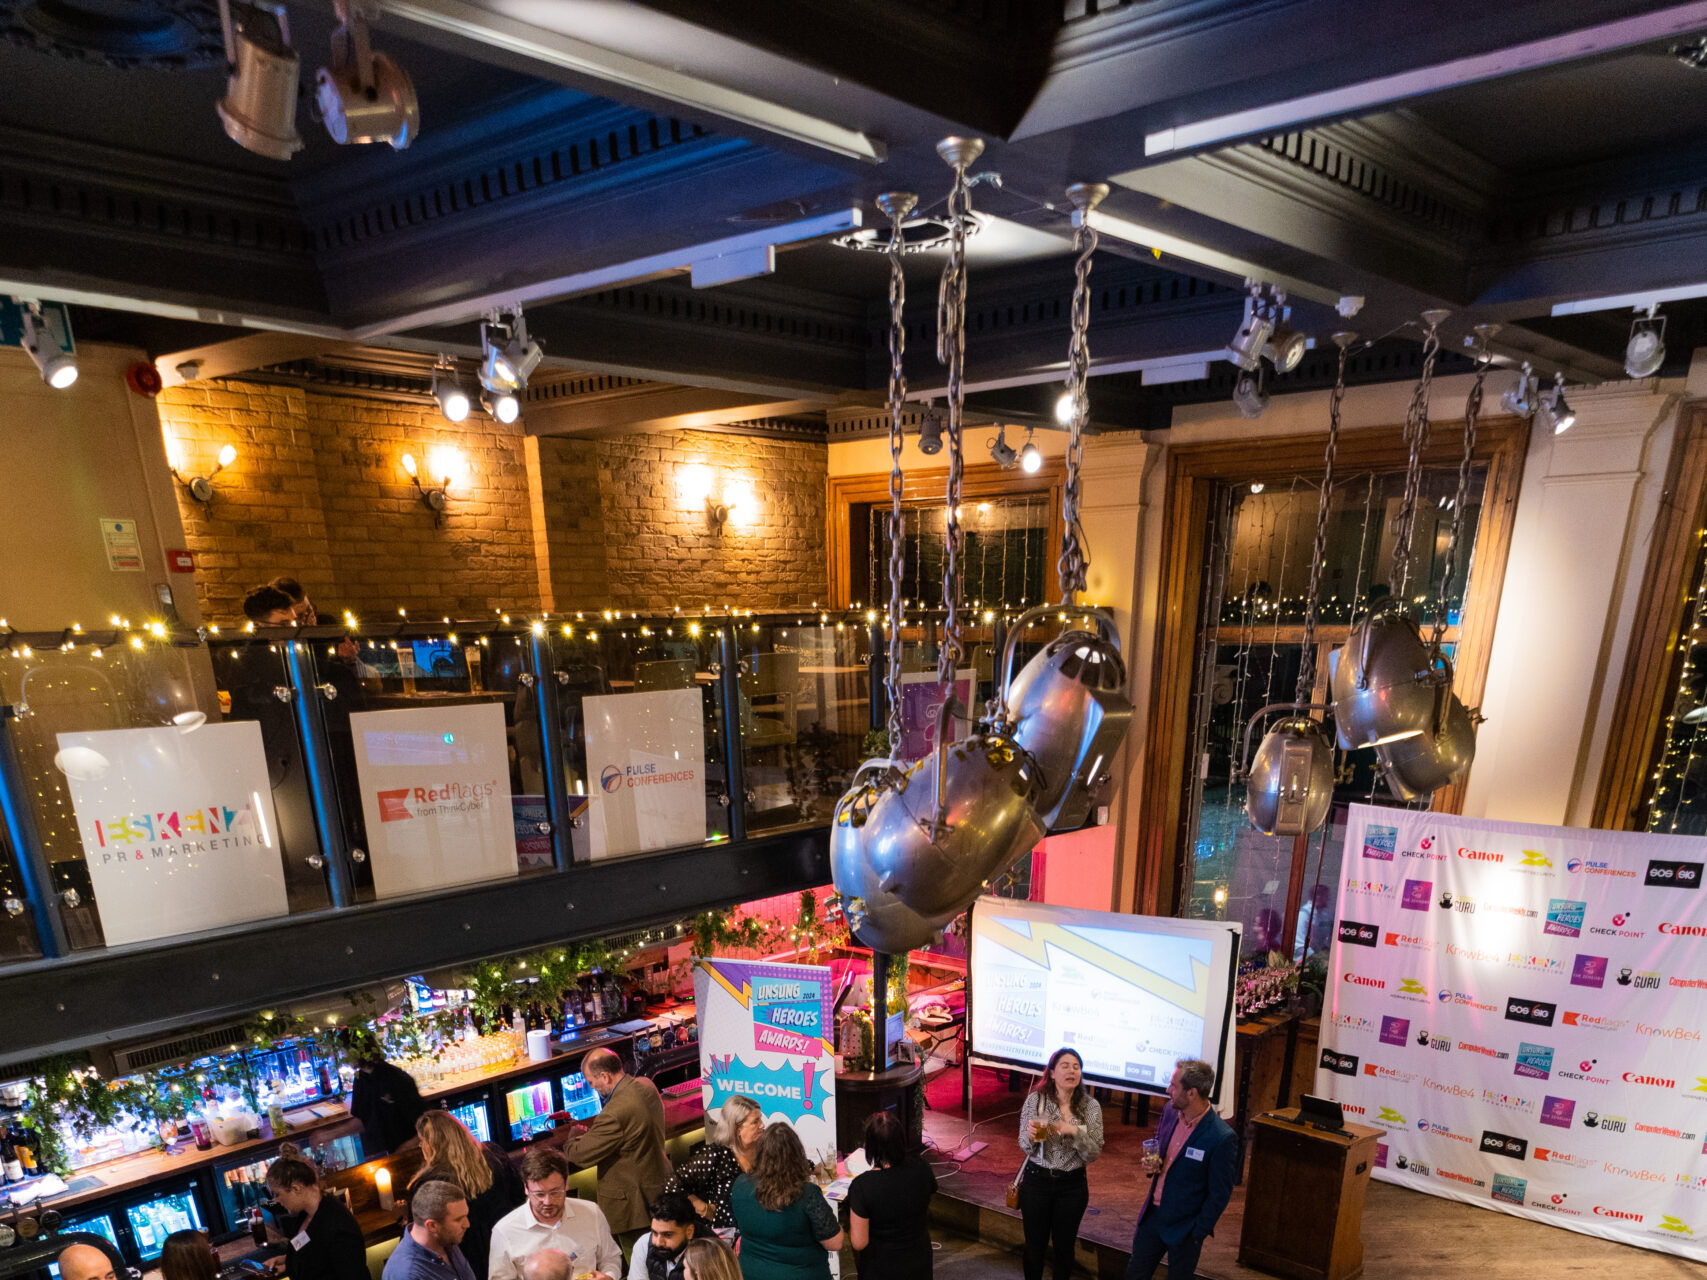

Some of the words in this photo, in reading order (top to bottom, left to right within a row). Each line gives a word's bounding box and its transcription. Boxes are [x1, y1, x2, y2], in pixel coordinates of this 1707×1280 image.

[626, 764, 656, 776] PULSE
[627, 770, 694, 788] CONFERENCES
[417, 808, 436, 816] from
[439, 802, 483, 815] ThinkCyber
[102, 851, 127, 864] PR
[135, 849, 144, 860] &
[1402, 850, 1425, 859] CHECK
[1426, 853, 1448, 861] POINT
[1458, 847, 1504, 863] Canon
[1584, 868, 1637, 878] CONFERENCES
[1454, 900, 1476, 913] GURU
[1590, 927, 1617, 936] CHECK
[1618, 930, 1645, 939] POINT
[1344, 972, 1386, 989] Canon
[1633, 975, 1661, 989] GURU
[757, 983, 801, 1001] UNSUNG
[802, 992, 816, 1000] 2024
[1455, 992, 1473, 1000] PULSE
[997, 997, 1040, 1017] HEROES
[1454, 998, 1498, 1012] CONFERENCES
[771, 1008, 819, 1027] HEROES
[1635, 1022, 1702, 1042] KnowBe4
[759, 1029, 810, 1054] AWARDS!
[1430, 1038, 1452, 1053] GURU
[1149, 1046, 1171, 1056] CHECK
[1558, 1071, 1584, 1081] CHECK
[1586, 1075, 1611, 1085] POINT
[1622, 1072, 1676, 1089] Canon
[1422, 1076, 1475, 1099] KnowBe4
[1431, 1123, 1450, 1132] PULSE
[1601, 1119, 1627, 1133] GURU
[1634, 1122, 1696, 1141] ComputerWeekly.com
[1431, 1128, 1473, 1144] CONFERENCES
[1410, 1162, 1430, 1176] GURU
[1603, 1161, 1667, 1184] KnowBe4
[1531, 1201, 1557, 1212] CHECK
[1558, 1207, 1582, 1217] POINT
[1593, 1205, 1644, 1223] Canon
